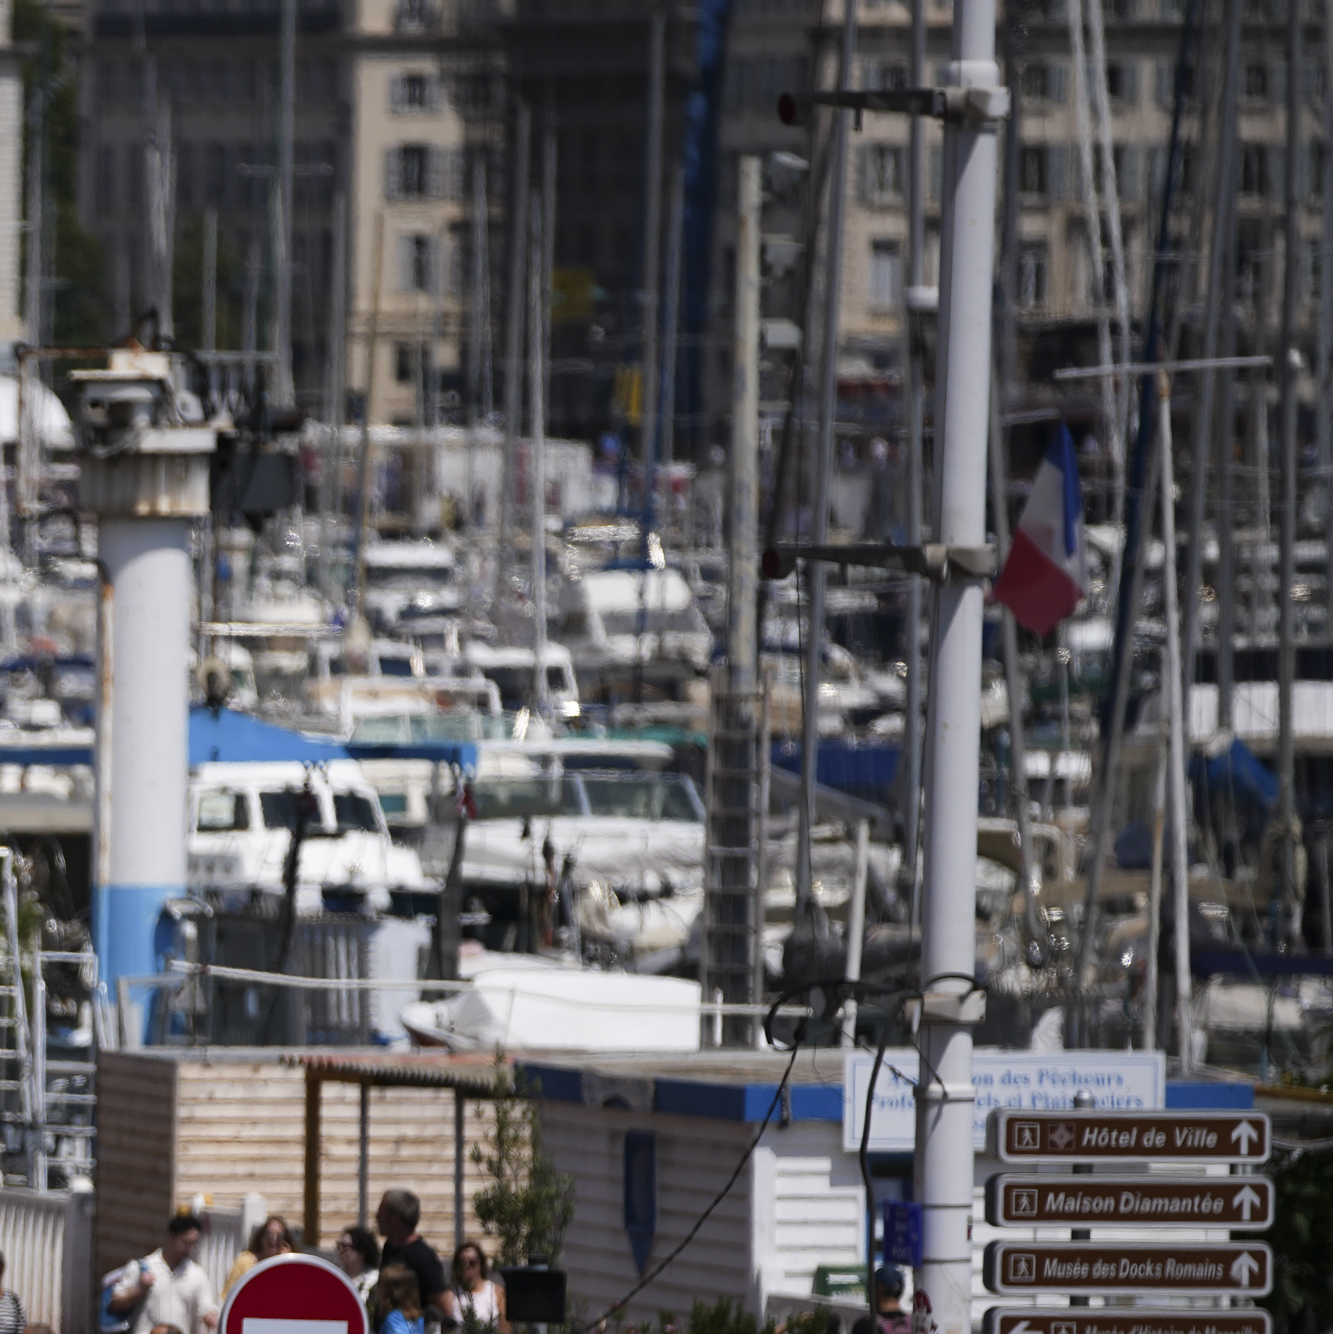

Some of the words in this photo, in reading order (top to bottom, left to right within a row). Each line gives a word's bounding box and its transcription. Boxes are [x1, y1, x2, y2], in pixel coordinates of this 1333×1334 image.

[1082, 1126, 1137, 1149] Hôtel
[1140, 1126, 1167, 1149] de
[1174, 1126, 1218, 1149] Ville
[1046, 1191, 1116, 1214] Maison
[1118, 1191, 1224, 1214] Diamantée
[1043, 1257, 1089, 1279] Musée
[1092, 1257, 1118, 1279] des
[1118, 1257, 1164, 1280] Docks
[1164, 1257, 1224, 1280] Romains
